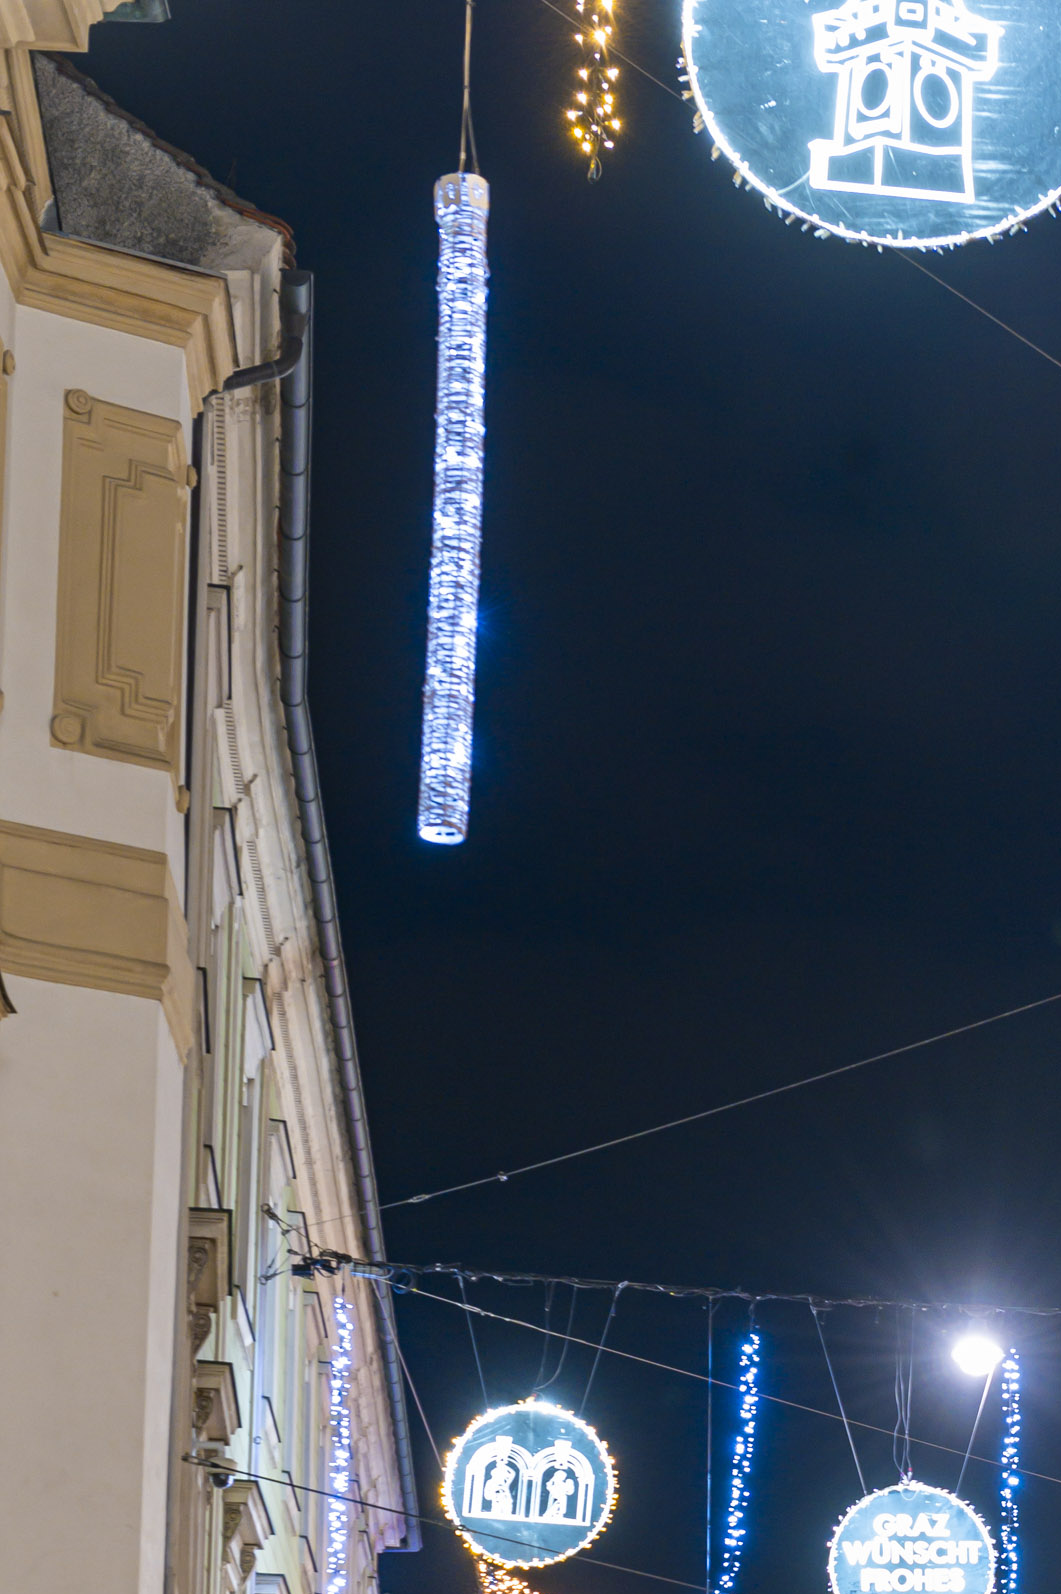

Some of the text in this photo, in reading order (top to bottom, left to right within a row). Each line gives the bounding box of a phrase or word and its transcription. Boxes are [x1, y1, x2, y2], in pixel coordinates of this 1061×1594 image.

[872, 1512, 951, 1538] GRAZ
[842, 1535, 983, 1565] WÜNSCHT
[860, 1567, 966, 1593] FROHES
